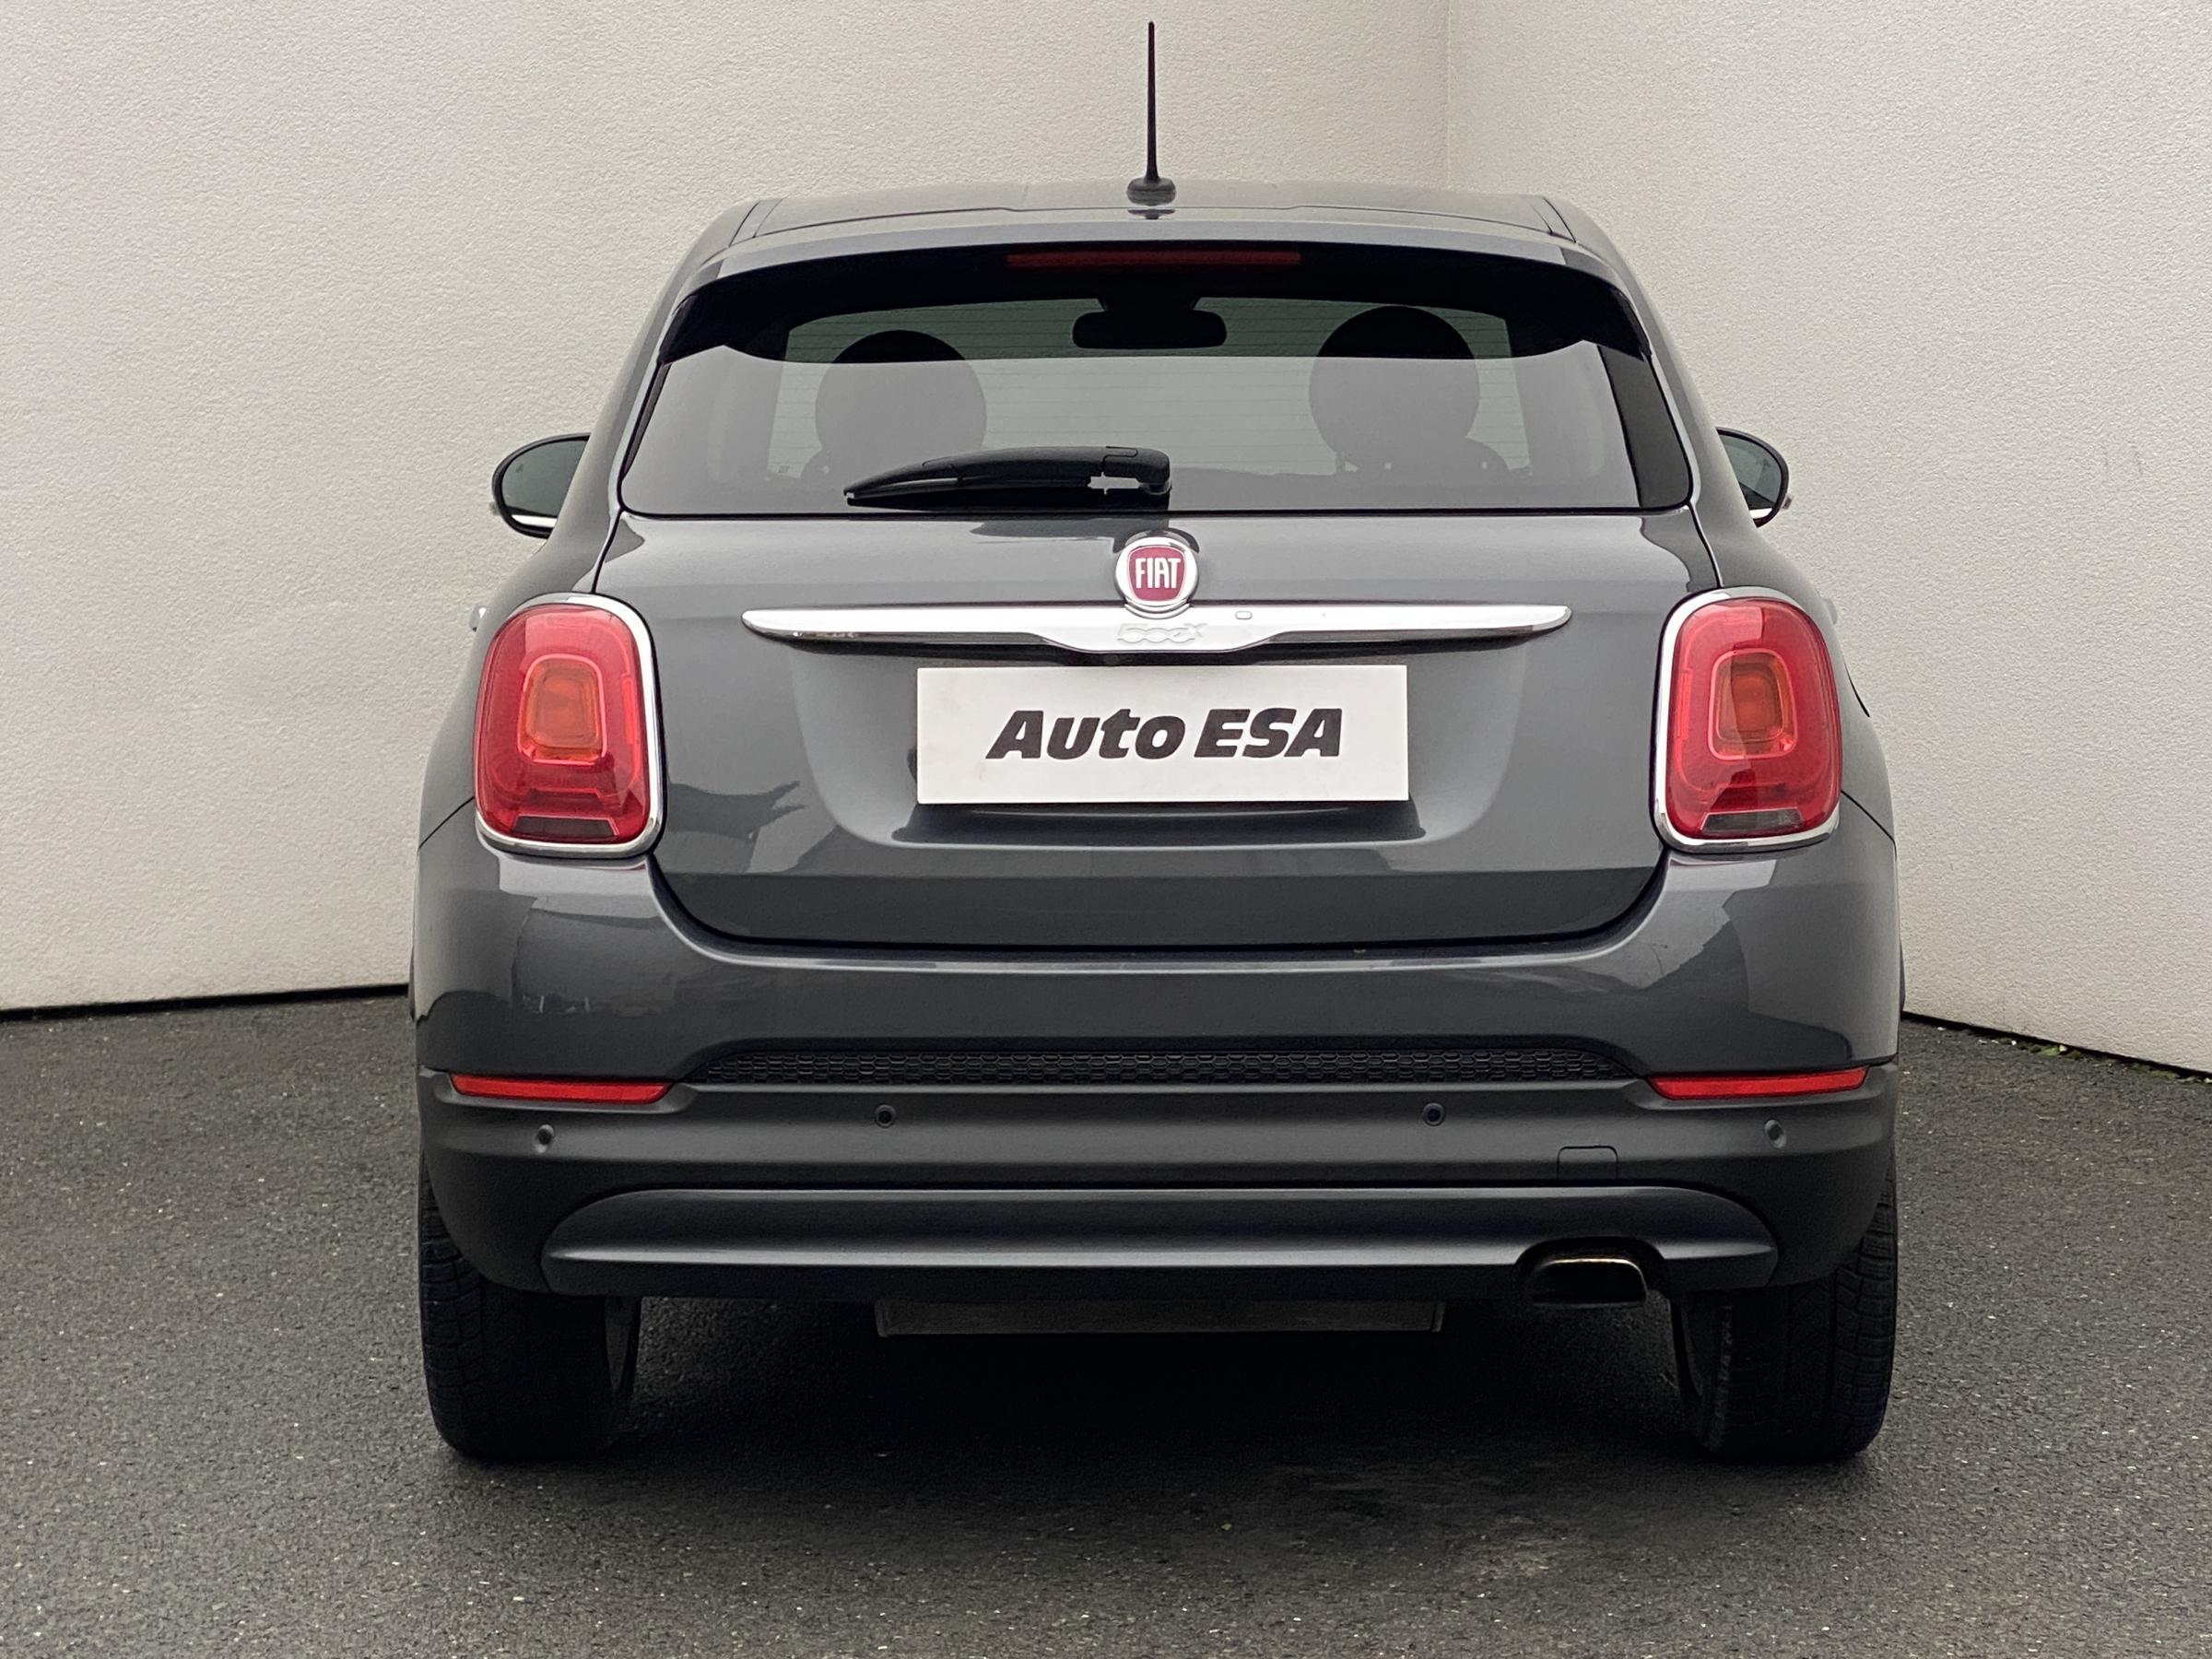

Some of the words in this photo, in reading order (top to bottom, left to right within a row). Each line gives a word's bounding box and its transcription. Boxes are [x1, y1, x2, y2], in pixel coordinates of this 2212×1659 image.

[1135, 558, 1181, 588] FIAT
[985, 709, 1186, 759] Auto
[1194, 708, 1343, 758] ESA
